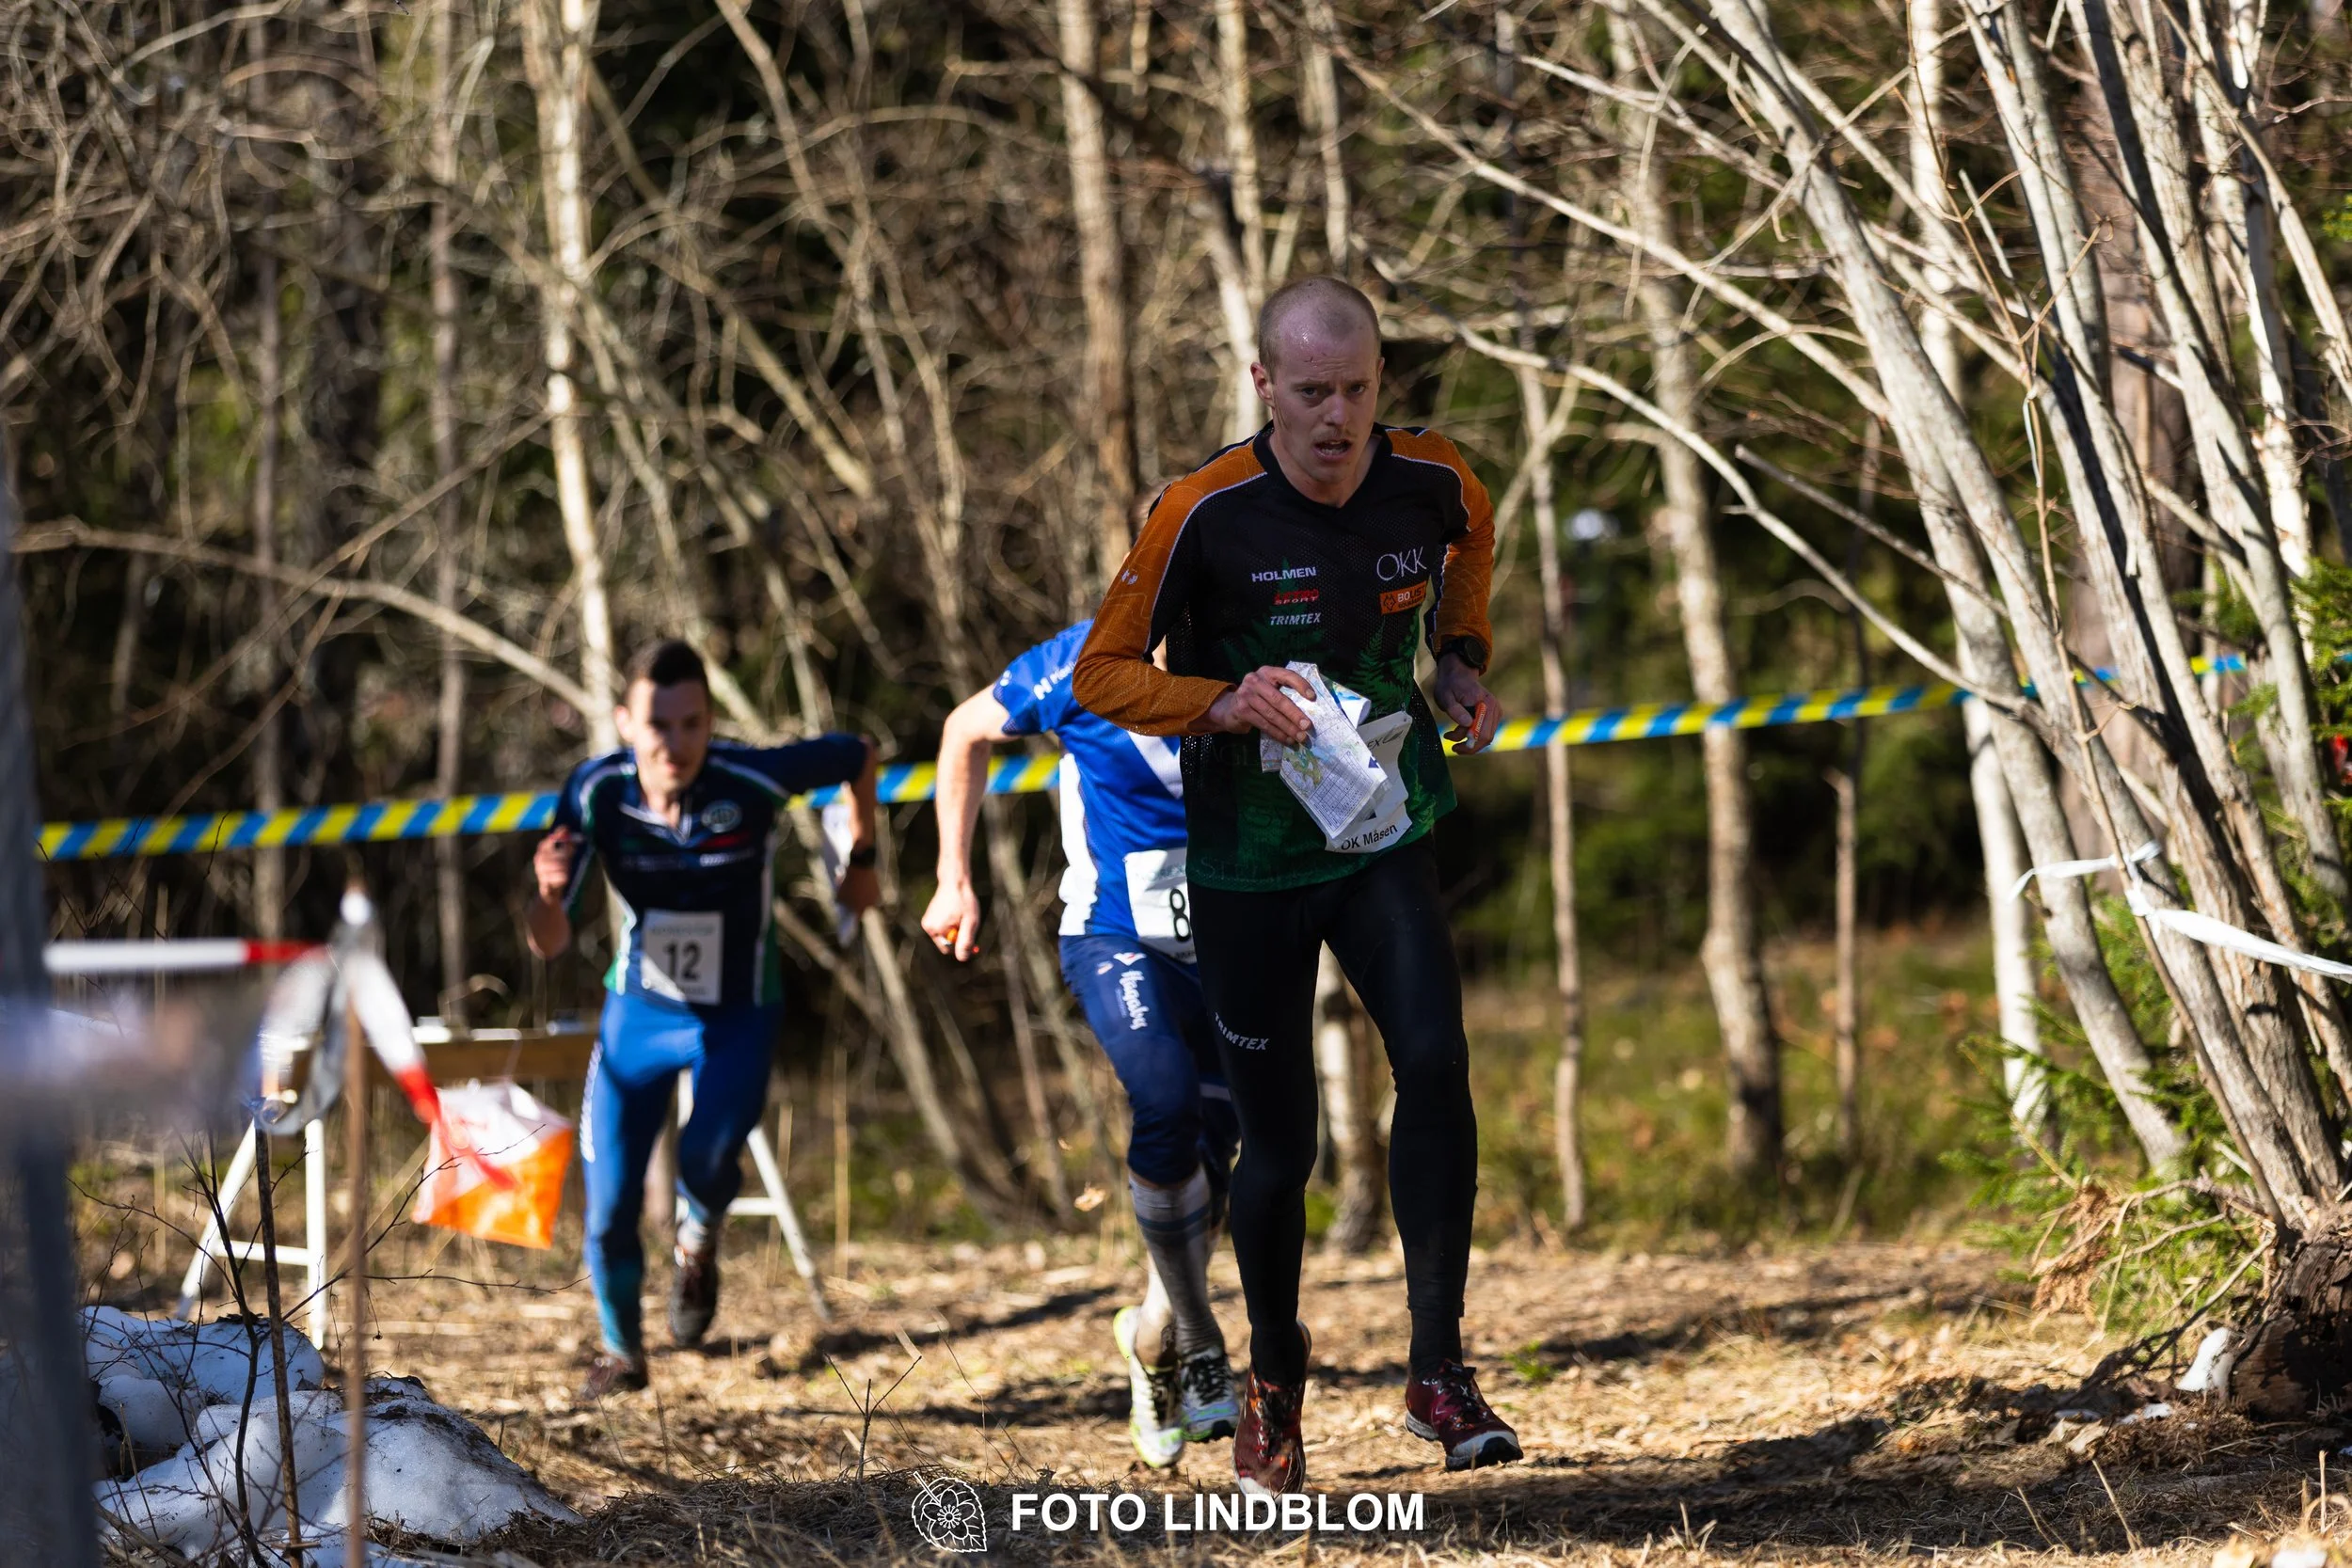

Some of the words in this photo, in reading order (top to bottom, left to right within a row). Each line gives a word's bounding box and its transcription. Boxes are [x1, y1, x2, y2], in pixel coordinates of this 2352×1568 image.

[1251, 566, 1317, 582] HOLMEN
[1376, 546, 1427, 581] OKK
[1270, 612, 1322, 626] TRIMTEX
[1341, 836, 1360, 851] OK
[1362, 824, 1398, 846] Måsen
[1169, 888, 1192, 942] 8
[662, 940, 702, 982] 12
[1215, 1011, 1270, 1051] TRIMTEX
